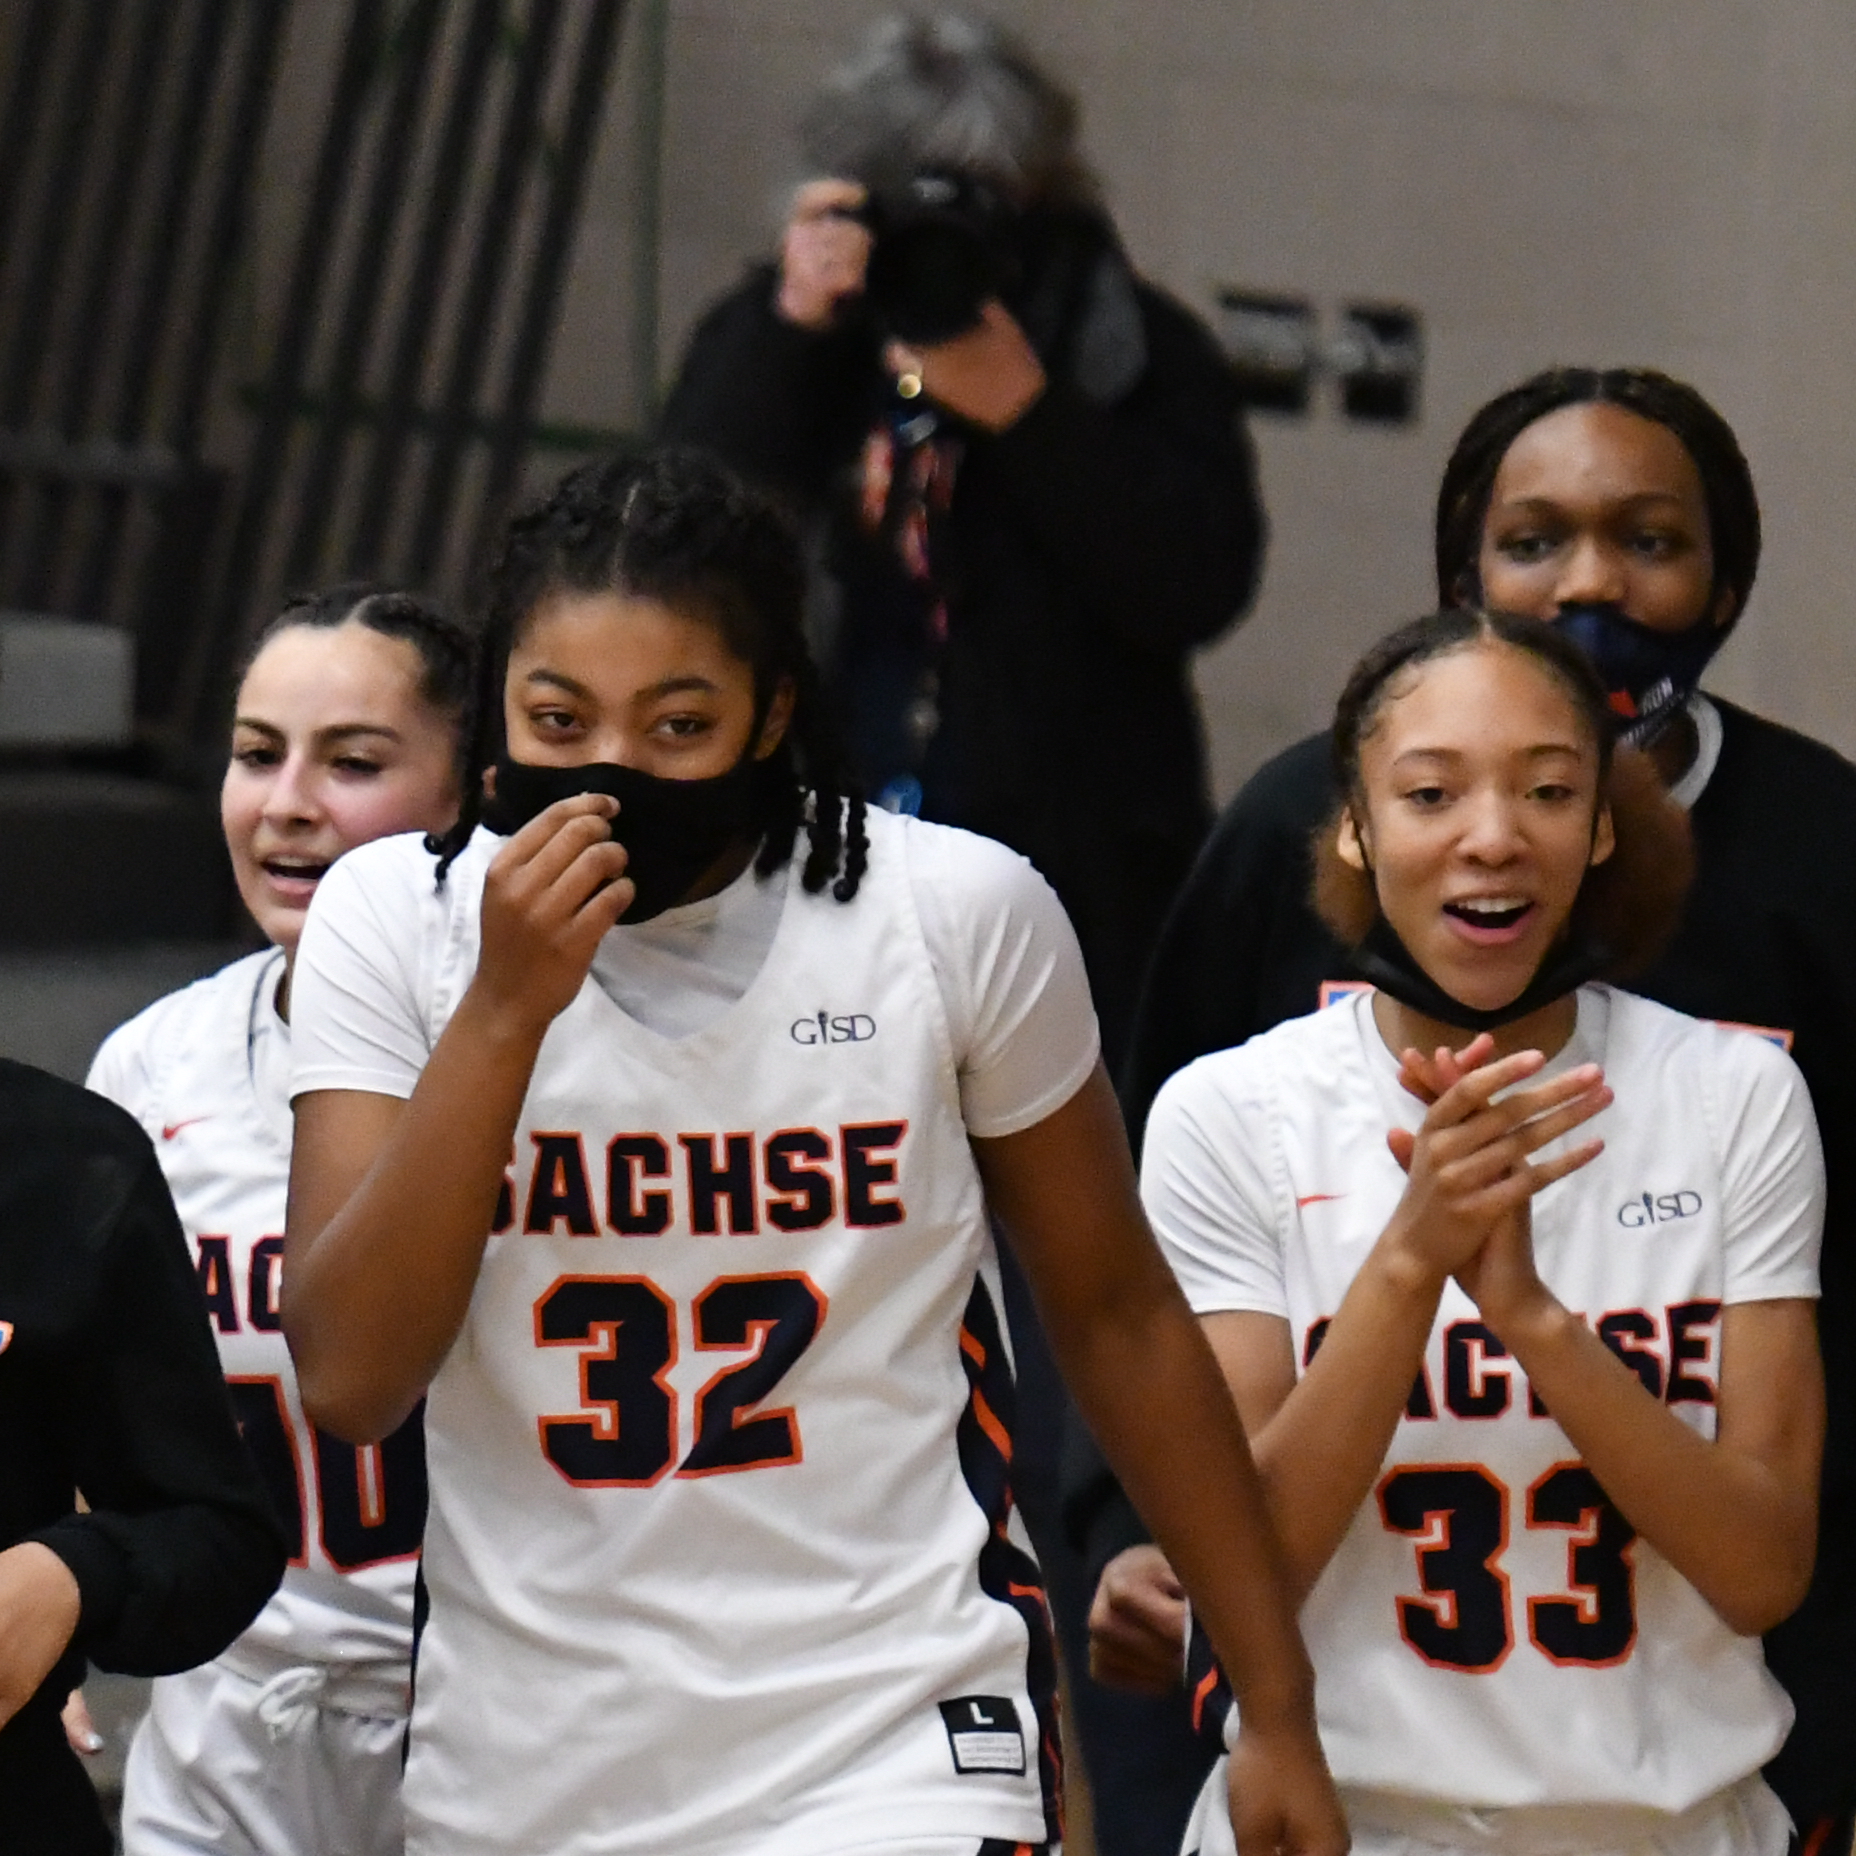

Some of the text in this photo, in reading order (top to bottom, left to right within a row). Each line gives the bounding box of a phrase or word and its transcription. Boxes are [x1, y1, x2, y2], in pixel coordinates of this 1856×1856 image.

[532, 1270, 829, 1488] 32
[1375, 1459, 1638, 1676] 33
[969, 1701, 995, 1725] L
